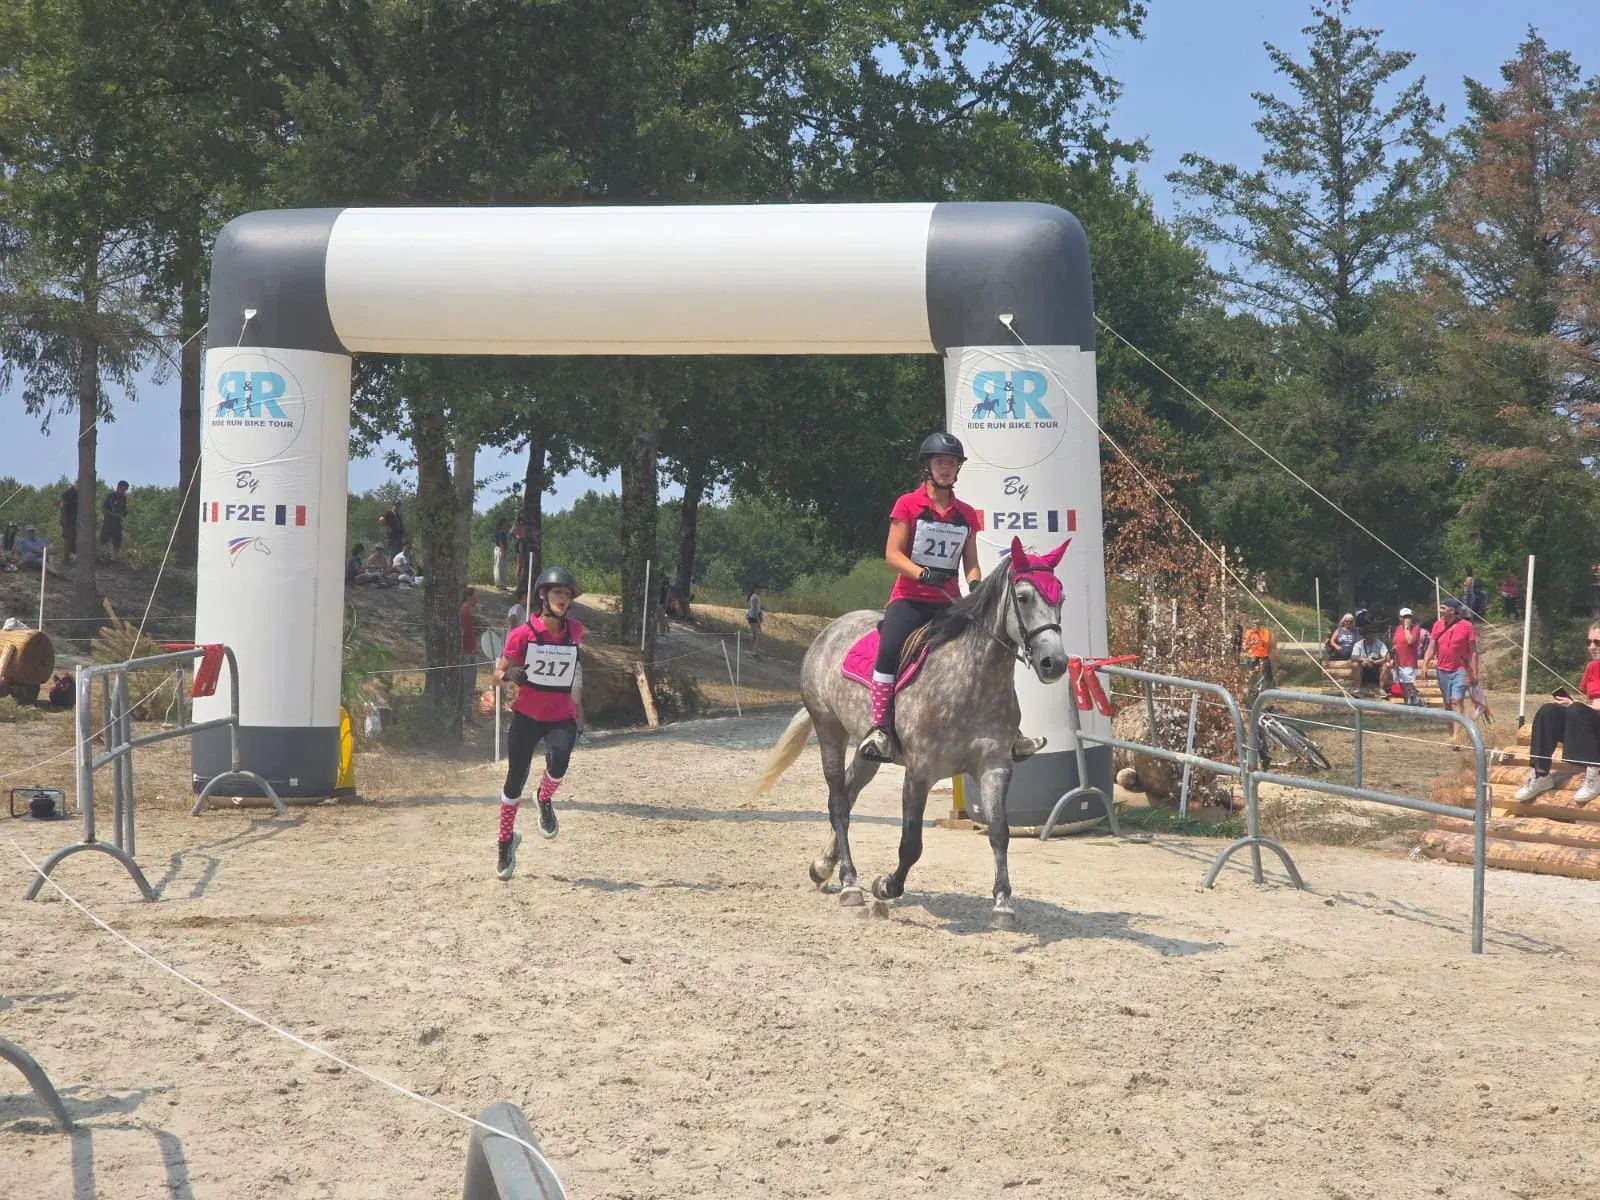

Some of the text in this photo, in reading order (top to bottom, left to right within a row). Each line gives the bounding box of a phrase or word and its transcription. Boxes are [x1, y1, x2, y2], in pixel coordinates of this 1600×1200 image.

[269, 420, 294, 428] TOUR
[967, 422, 985, 430] RIDE
[1034, 421, 1058, 429] TOUR
[235, 470, 259, 494] By
[1003, 475, 1030, 500] By
[225, 504, 266, 522] F2E
[993, 511, 1038, 530] F2E
[923, 538, 961, 559] 217
[533, 660, 570, 677] 217
